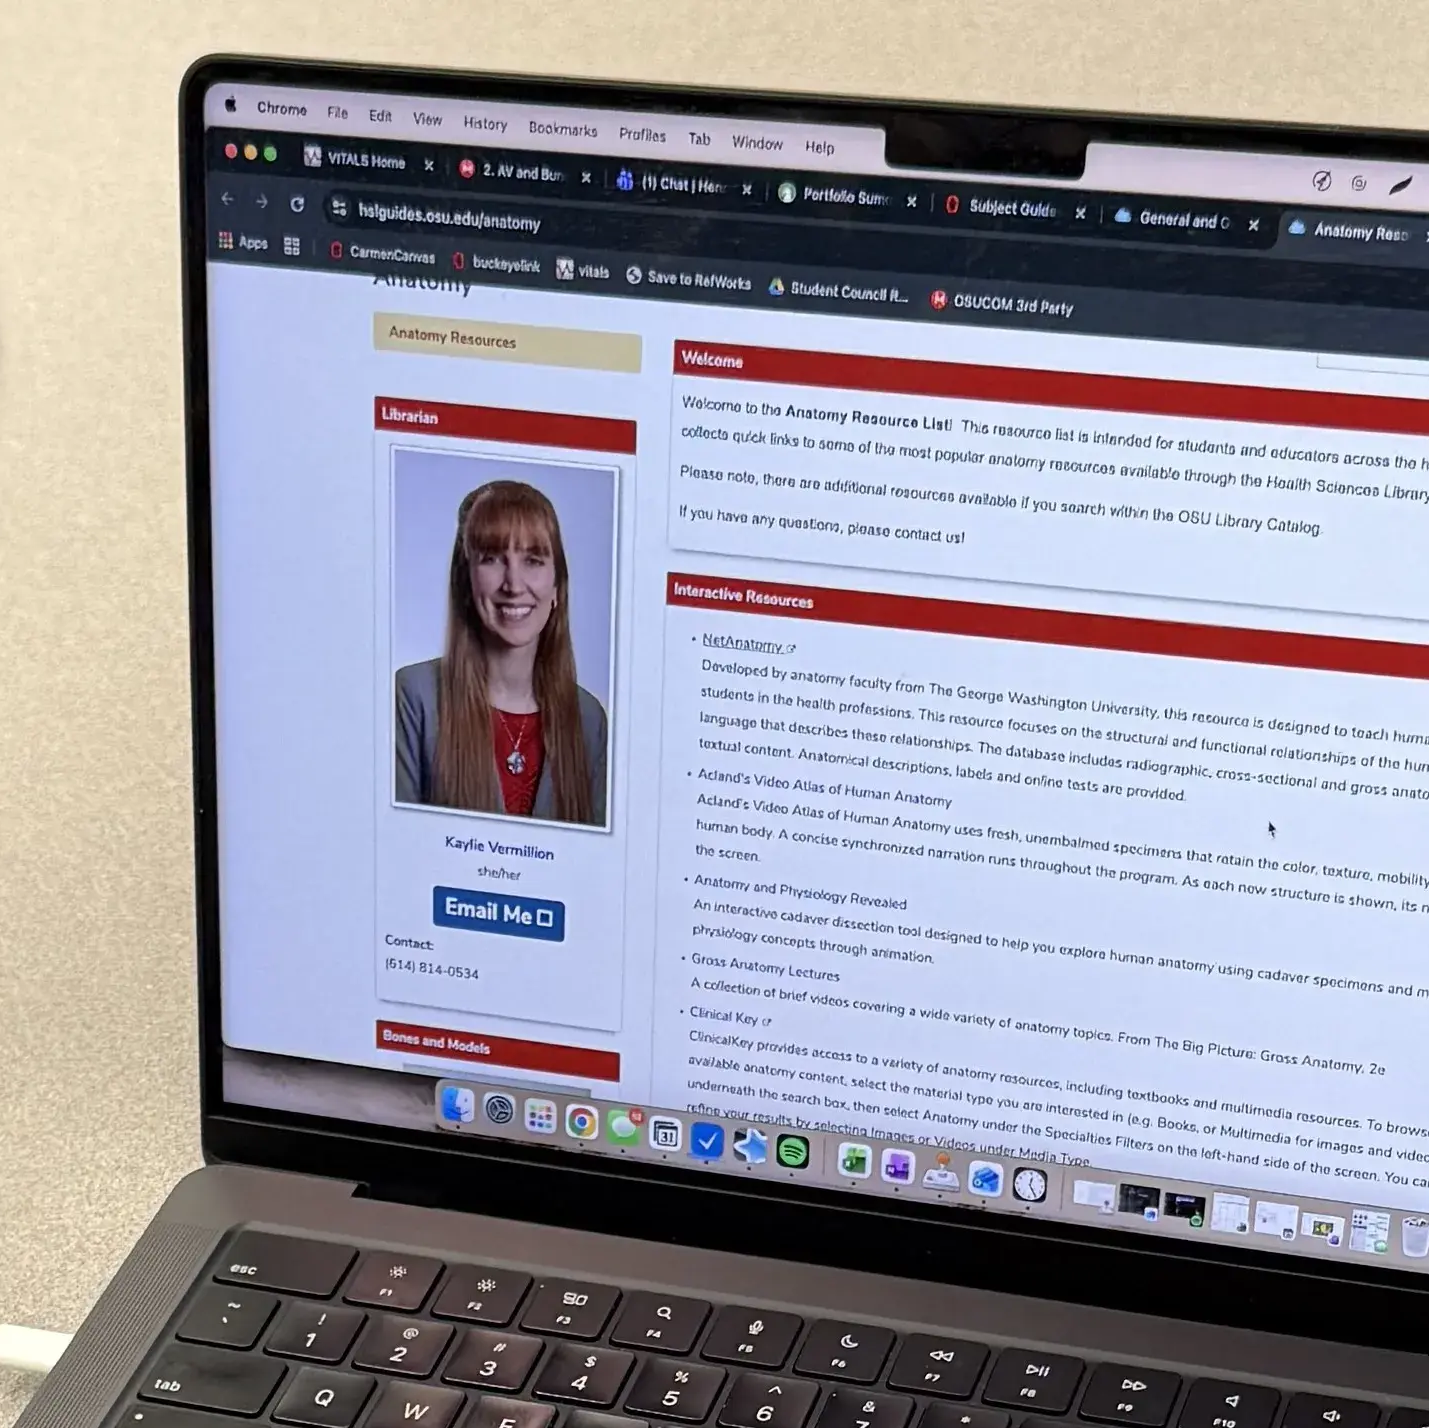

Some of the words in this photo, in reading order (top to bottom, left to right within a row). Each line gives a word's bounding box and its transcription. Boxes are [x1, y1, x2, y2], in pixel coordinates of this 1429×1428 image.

[257, 100, 307, 116] Chrome
[327, 105, 348, 119] File
[369, 109, 392, 122] Edit
[412, 111, 443, 126] View
[463, 115, 508, 133] History
[529, 120, 598, 137] Bookmarks
[619, 126, 666, 142] Profiles
[688, 131, 711, 146] Tab
[732, 135, 784, 150] Window
[805, 140, 835, 156] Help
[327, 151, 369, 166] VITALS
[371, 154, 406, 169] Home
[483, 163, 495, 176] 2.
[497, 164, 514, 177] AV
[515, 167, 539, 180] and
[1314, 222, 1373, 241] Anatomy
[238, 235, 268, 250] Apps
[349, 245, 435, 264] CarmenCanvas
[472, 255, 540, 273] buckeyelink
[578, 265, 610, 278] vitals
[648, 269, 677, 284] Save
[679, 272, 692, 285] to
[694, 273, 751, 290] RefWorks
[791, 281, 839, 297] Student
[841, 285, 887, 301] Council
[953, 294, 1013, 310] OSUCOM
[1015, 299, 1038, 312] 3rd
[1040, 299, 1074, 318] Party
[389, 325, 447, 344] Anatomy
[450, 330, 516, 348] Resources
[681, 350, 743, 368] Welcome
[381, 406, 439, 424] Librarian
[682, 395, 741, 412] Welcome
[745, 402, 758, 414] to
[761, 402, 781, 416] the
[784, 404, 848, 425] Anatomy
[851, 410, 918, 428] Resource
[922, 416, 952, 431] List!
[679, 504, 687, 517] If
[690, 509, 713, 521] you
[716, 509, 748, 523] have
[751, 514, 775, 528] any
[778, 517, 843, 534] questions,
[847, 522, 890, 537] please
[894, 528, 941, 542] contact
[945, 531, 965, 544] us!
[673, 582, 743, 601] Interactive
[745, 589, 813, 608] Resources
[702, 633, 784, 654] NetAnatomy
[697, 768, 750, 784] Acland's
[753, 774, 790, 789] Video
[792, 779, 825, 793] Atlas
[828, 783, 842, 795] of
[844, 785, 890, 800] Human
[893, 790, 952, 810] Anatomy
[445, 836, 484, 852] Kaylie
[487, 841, 554, 860] Vermillion
[477, 866, 521, 880] she/her
[693, 874, 750, 892] Anatomy
[753, 883, 777, 894] and
[779, 884, 847, 904] Physiology
[850, 892, 907, 910] Revealed
[445, 896, 498, 920] Email
[503, 904, 532, 925] Me
[384, 934, 434, 950] Contact:
[385, 957, 415, 973] (614)
[419, 961, 479, 979] 814-0534
[691, 952, 727, 967] Gross
[729, 957, 785, 976] Anatomy
[788, 965, 840, 982] Lectures
[689, 1005, 733, 1021] Clinical
[735, 1012, 758, 1027] Key
[382, 1028, 420, 1045] Bones
[422, 1037, 445, 1048] and
[447, 1038, 490, 1054] Models
[230, 1264, 258, 1275] esc
[306, 1333, 316, 1348] 1
[389, 1347, 408, 1362] 2
[480, 1361, 497, 1376] 3
[154, 1379, 181, 1392] tab
[571, 1376, 588, 1391] 4
[315, 1389, 334, 1407] Q
[662, 1390, 680, 1406] 5
[404, 1402, 430, 1420] W
[756, 1406, 774, 1422] 6
